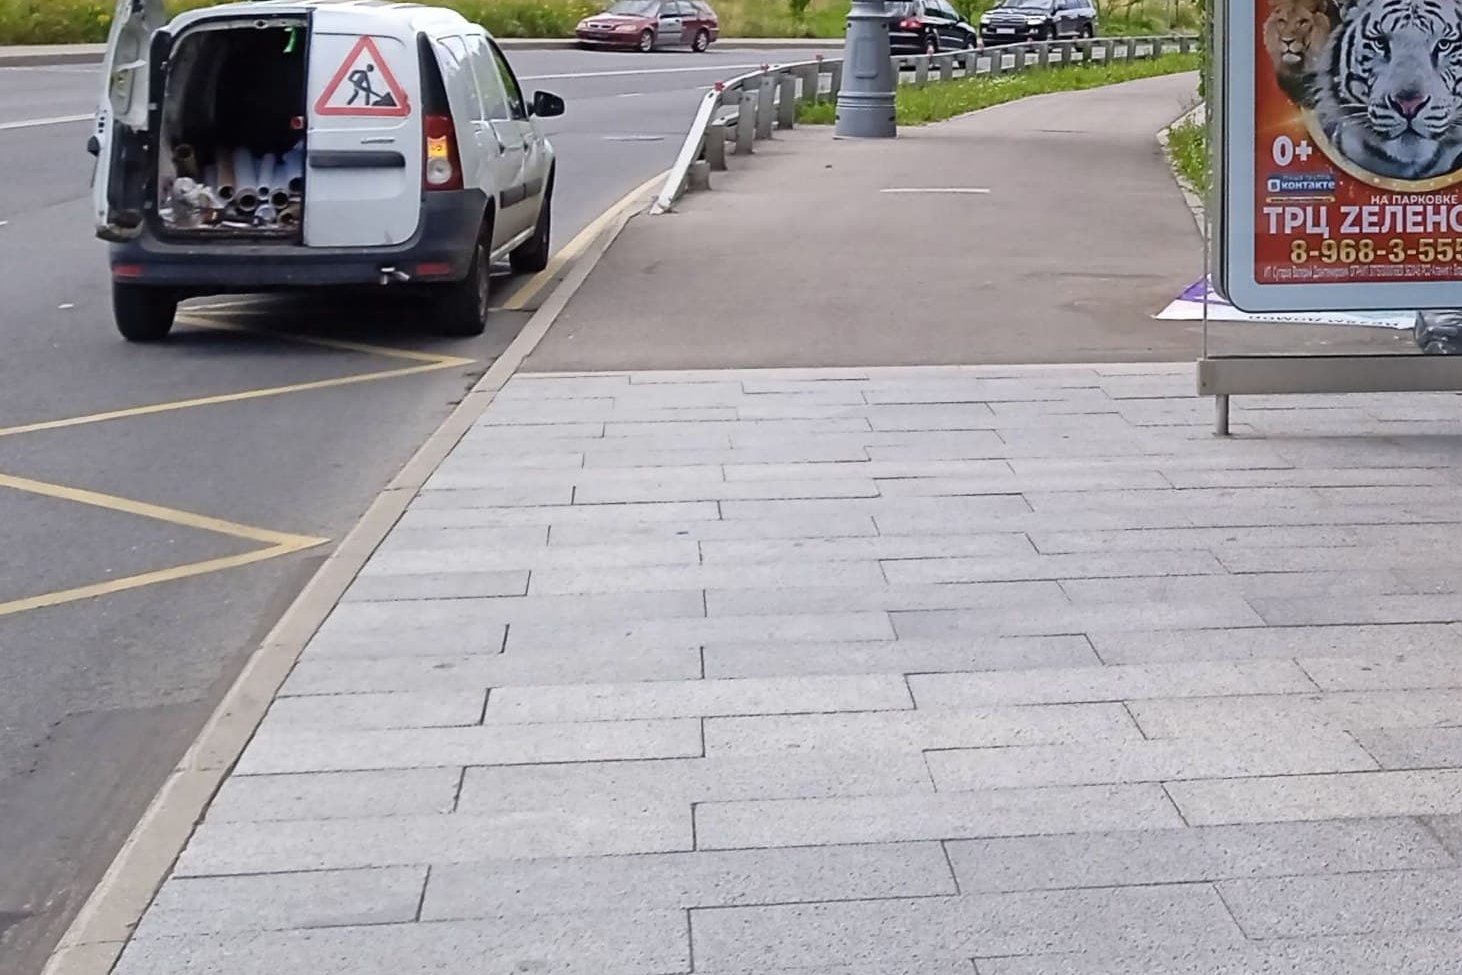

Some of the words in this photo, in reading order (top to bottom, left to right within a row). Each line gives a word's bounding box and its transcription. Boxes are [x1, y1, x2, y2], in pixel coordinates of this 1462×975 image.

[1272, 135, 1313, 167] 0+
[1371, 195, 1388, 205] НА
[1392, 194, 1459, 205] ПАРКОВКЕ
[1264, 206, 1330, 239] ТРЦ
